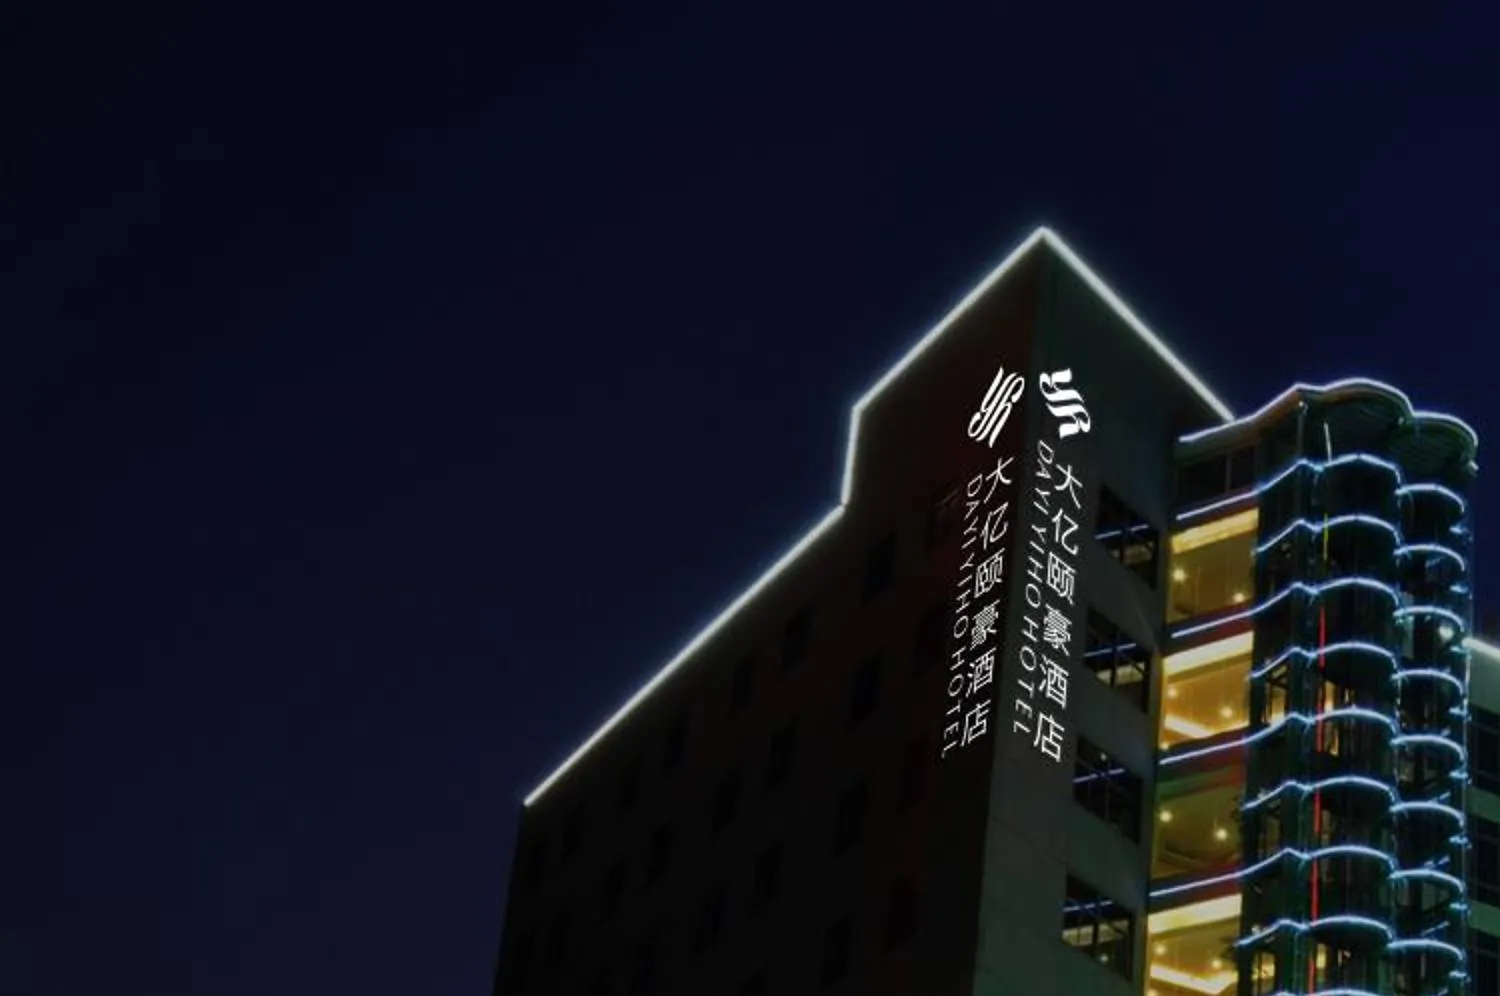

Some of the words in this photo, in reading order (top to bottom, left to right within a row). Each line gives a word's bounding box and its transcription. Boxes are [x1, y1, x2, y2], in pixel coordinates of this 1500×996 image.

[961, 474, 984, 549] DAYI
[1034, 439, 1056, 515] DAYI
[960, 456, 1015, 748] 大亿颐豪酒店
[1033, 464, 1084, 764] 大亿颐豪酒店
[941, 646, 967, 758] HOTEL
[1013, 615, 1039, 734] HOTEL
